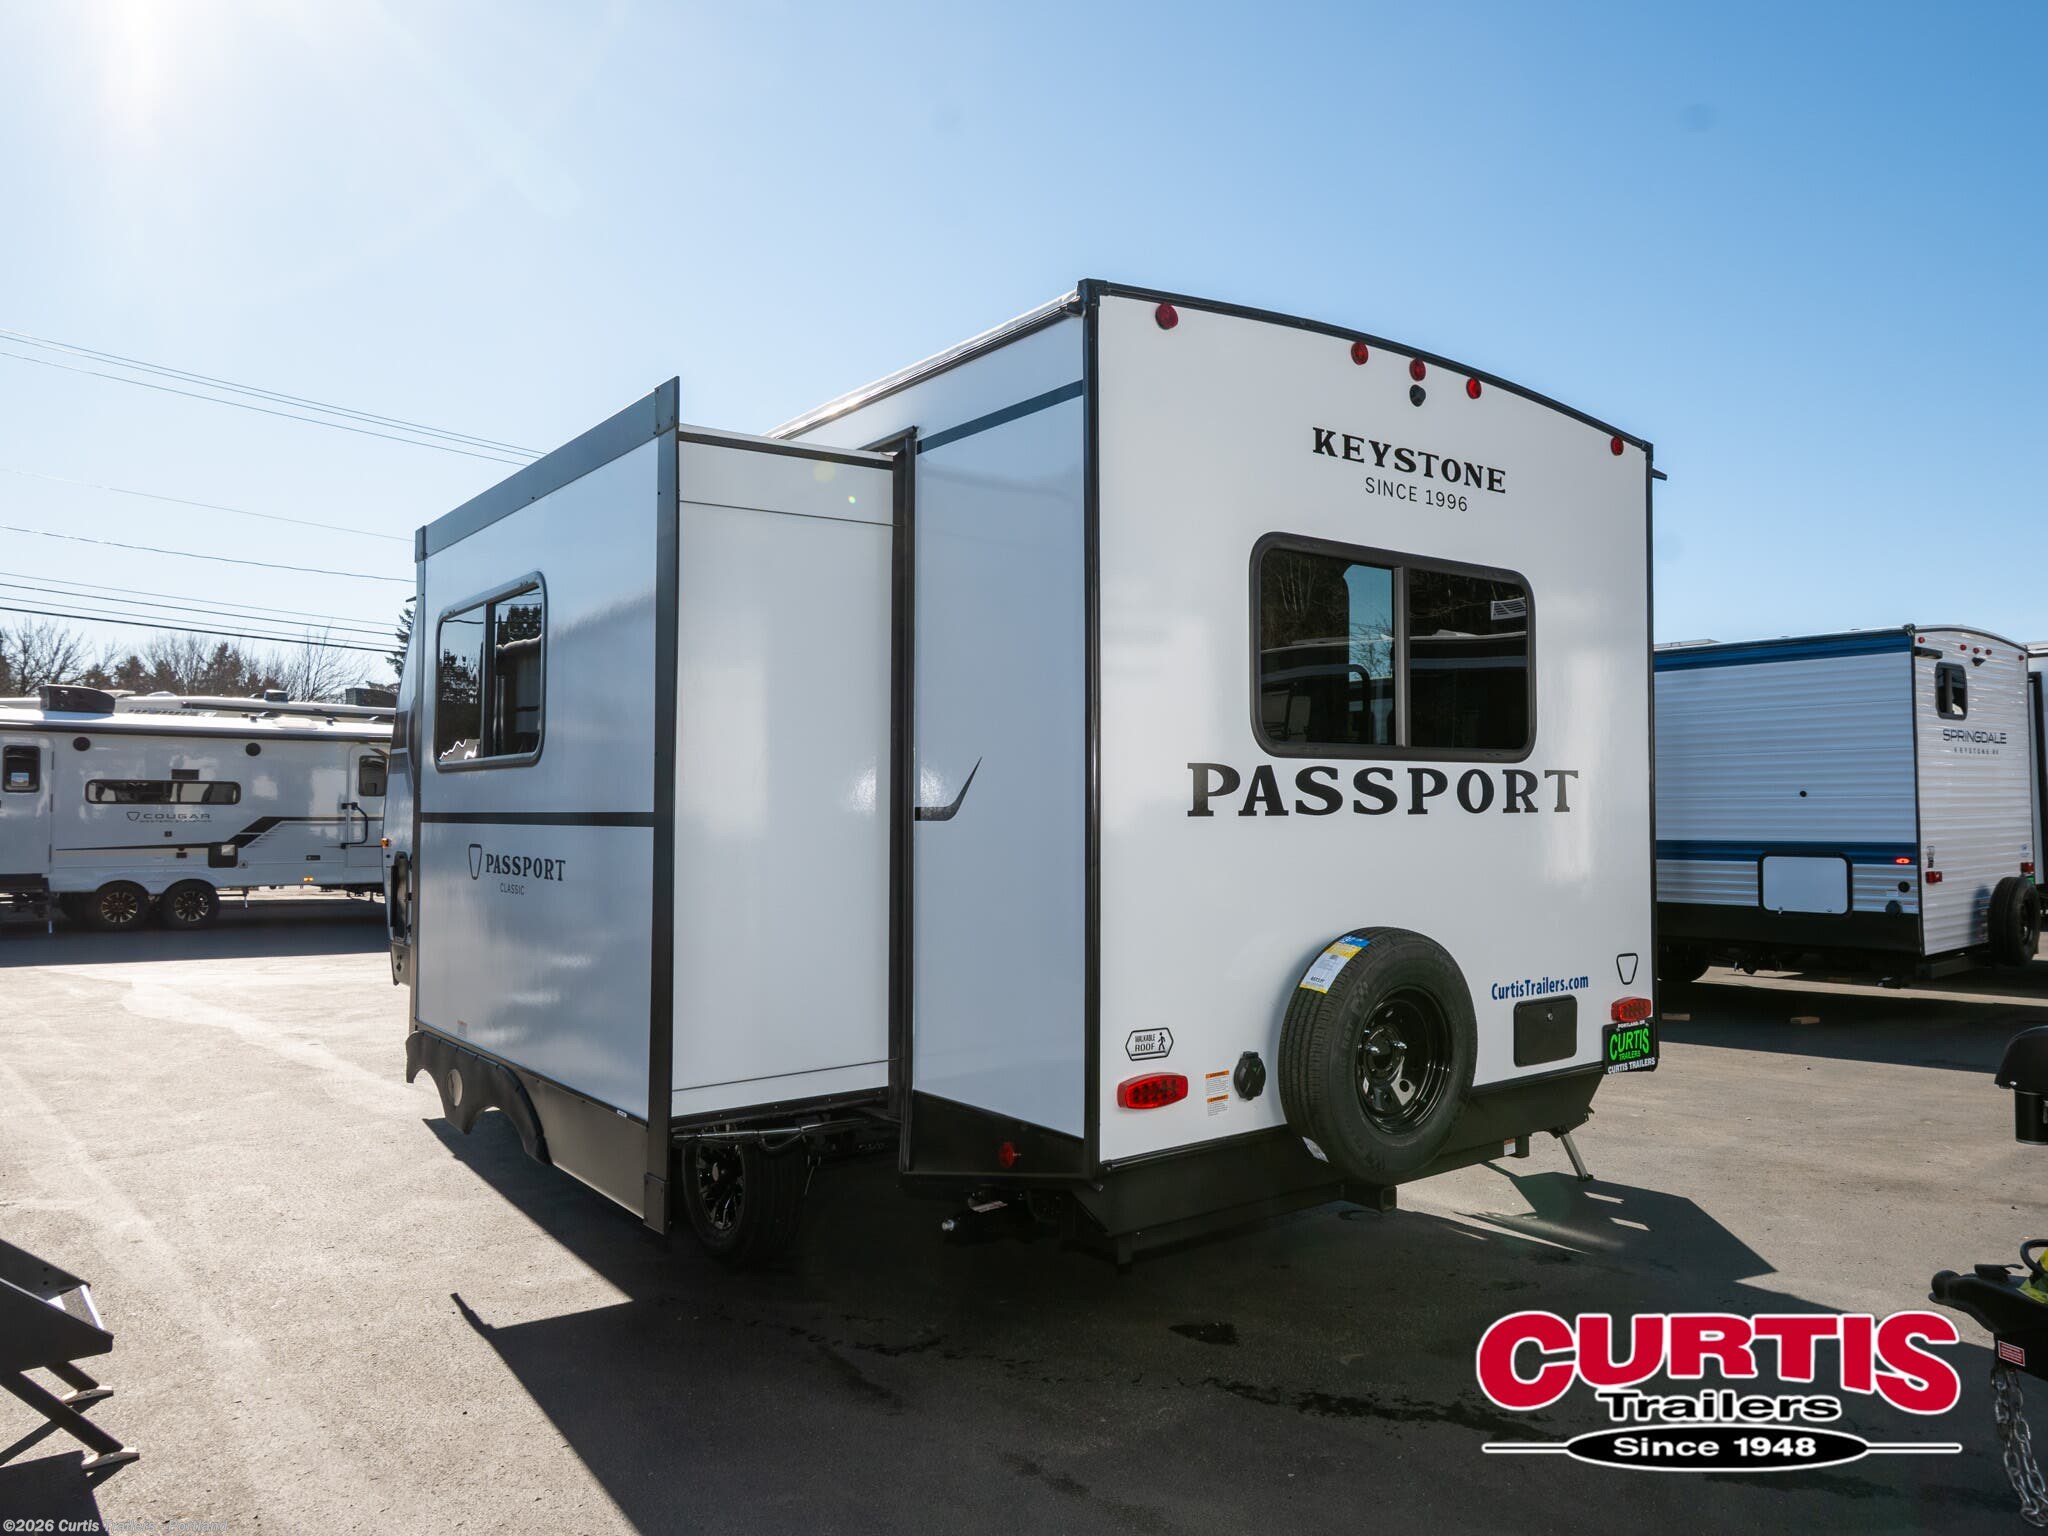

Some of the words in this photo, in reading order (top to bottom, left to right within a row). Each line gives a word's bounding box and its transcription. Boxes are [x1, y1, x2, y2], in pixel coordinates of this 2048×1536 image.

[1313, 427, 1507, 494] KEYSTONE
[1365, 477, 1418, 503] SINCE
[1426, 489, 1468, 512] 1996
[1943, 729, 2007, 744] SPRINGDALE
[1187, 763, 1579, 817] PASSPORT
[486, 853, 566, 881] PASSPORT
[499, 882, 525, 895] CLASSIC
[1491, 976, 1589, 1000] CurtisTrailers.com
[1134, 1034, 1156, 1042] WALKABLE
[1134, 1043, 1156, 1052] ROOF
[1609, 1028, 1650, 1061] CURTIS
[1607, 1063, 1629, 1074] CURTIS
[1629, 1057, 1656, 1070] TRAILERS
[1619, 1050, 1641, 1061] TRAILERS
